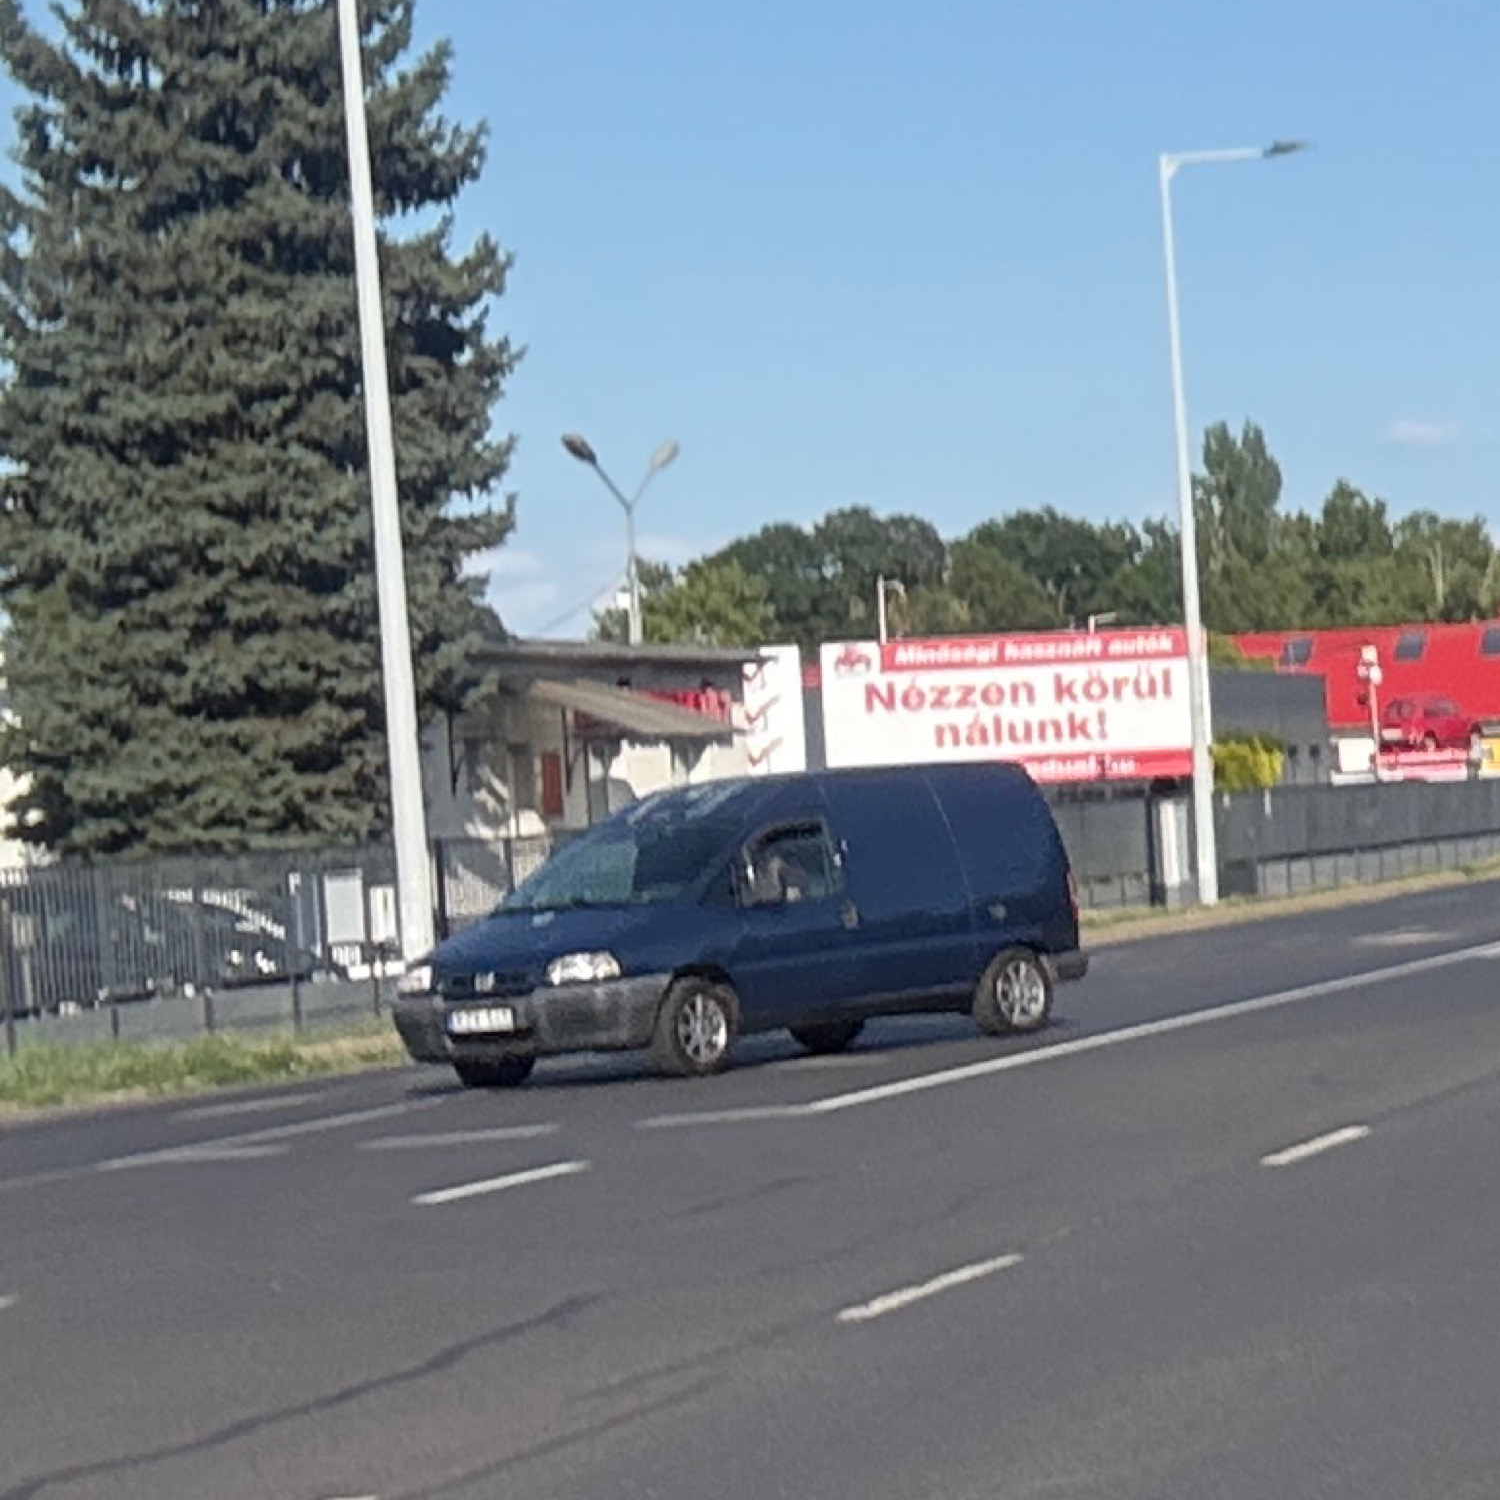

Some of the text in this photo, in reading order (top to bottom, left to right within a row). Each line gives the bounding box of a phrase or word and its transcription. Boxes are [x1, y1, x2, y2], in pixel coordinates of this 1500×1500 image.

[863, 666, 1173, 714] Nézzen körül
[934, 707, 1108, 748] nálunk!
